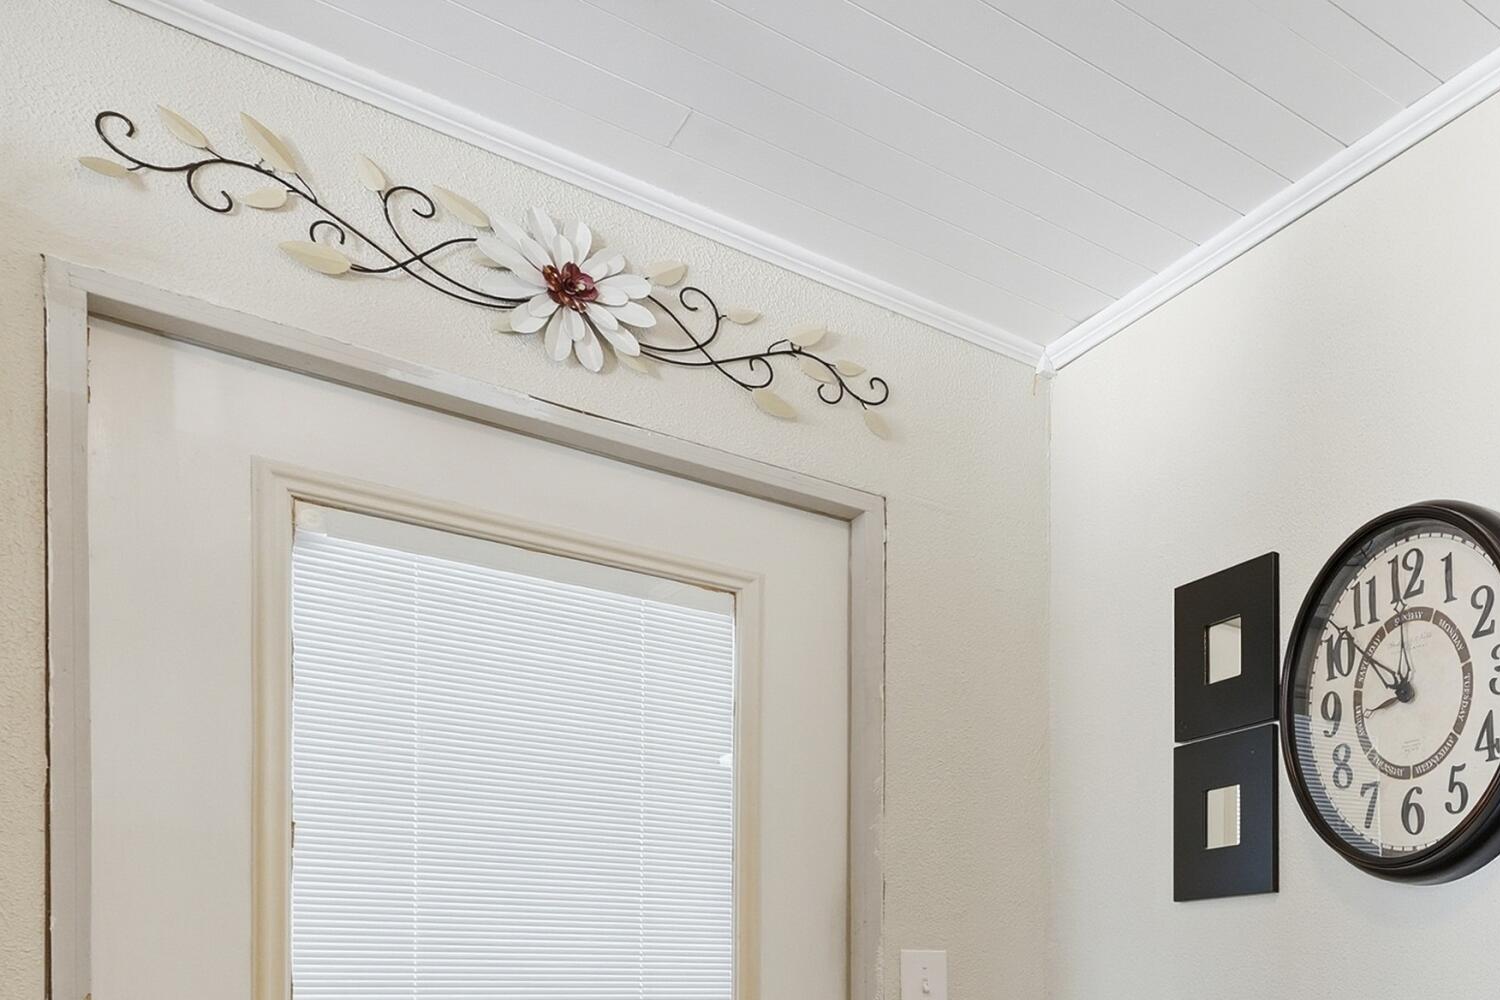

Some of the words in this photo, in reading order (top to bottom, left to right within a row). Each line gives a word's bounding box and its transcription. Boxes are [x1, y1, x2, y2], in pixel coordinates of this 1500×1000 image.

[1387, 548, 1425, 604] 12
[1440, 552, 1458, 603] 1
[1350, 575, 1380, 629] 11
[1393, 611, 1424, 627] SNDAY
[1470, 585, 1495, 639] 2
[1320, 628, 1356, 681] 10
[1439, 618, 1465, 651] MONDAY
[1320, 691, 1342, 737] 9
[1458, 672, 1472, 721] TUESDAY
[1474, 709, 1500, 762] 4
[1332, 743, 1353, 789] 8
[1444, 763, 1469, 814] 5
[1360, 781, 1379, 829] 7
[1401, 786, 1425, 836] 6
